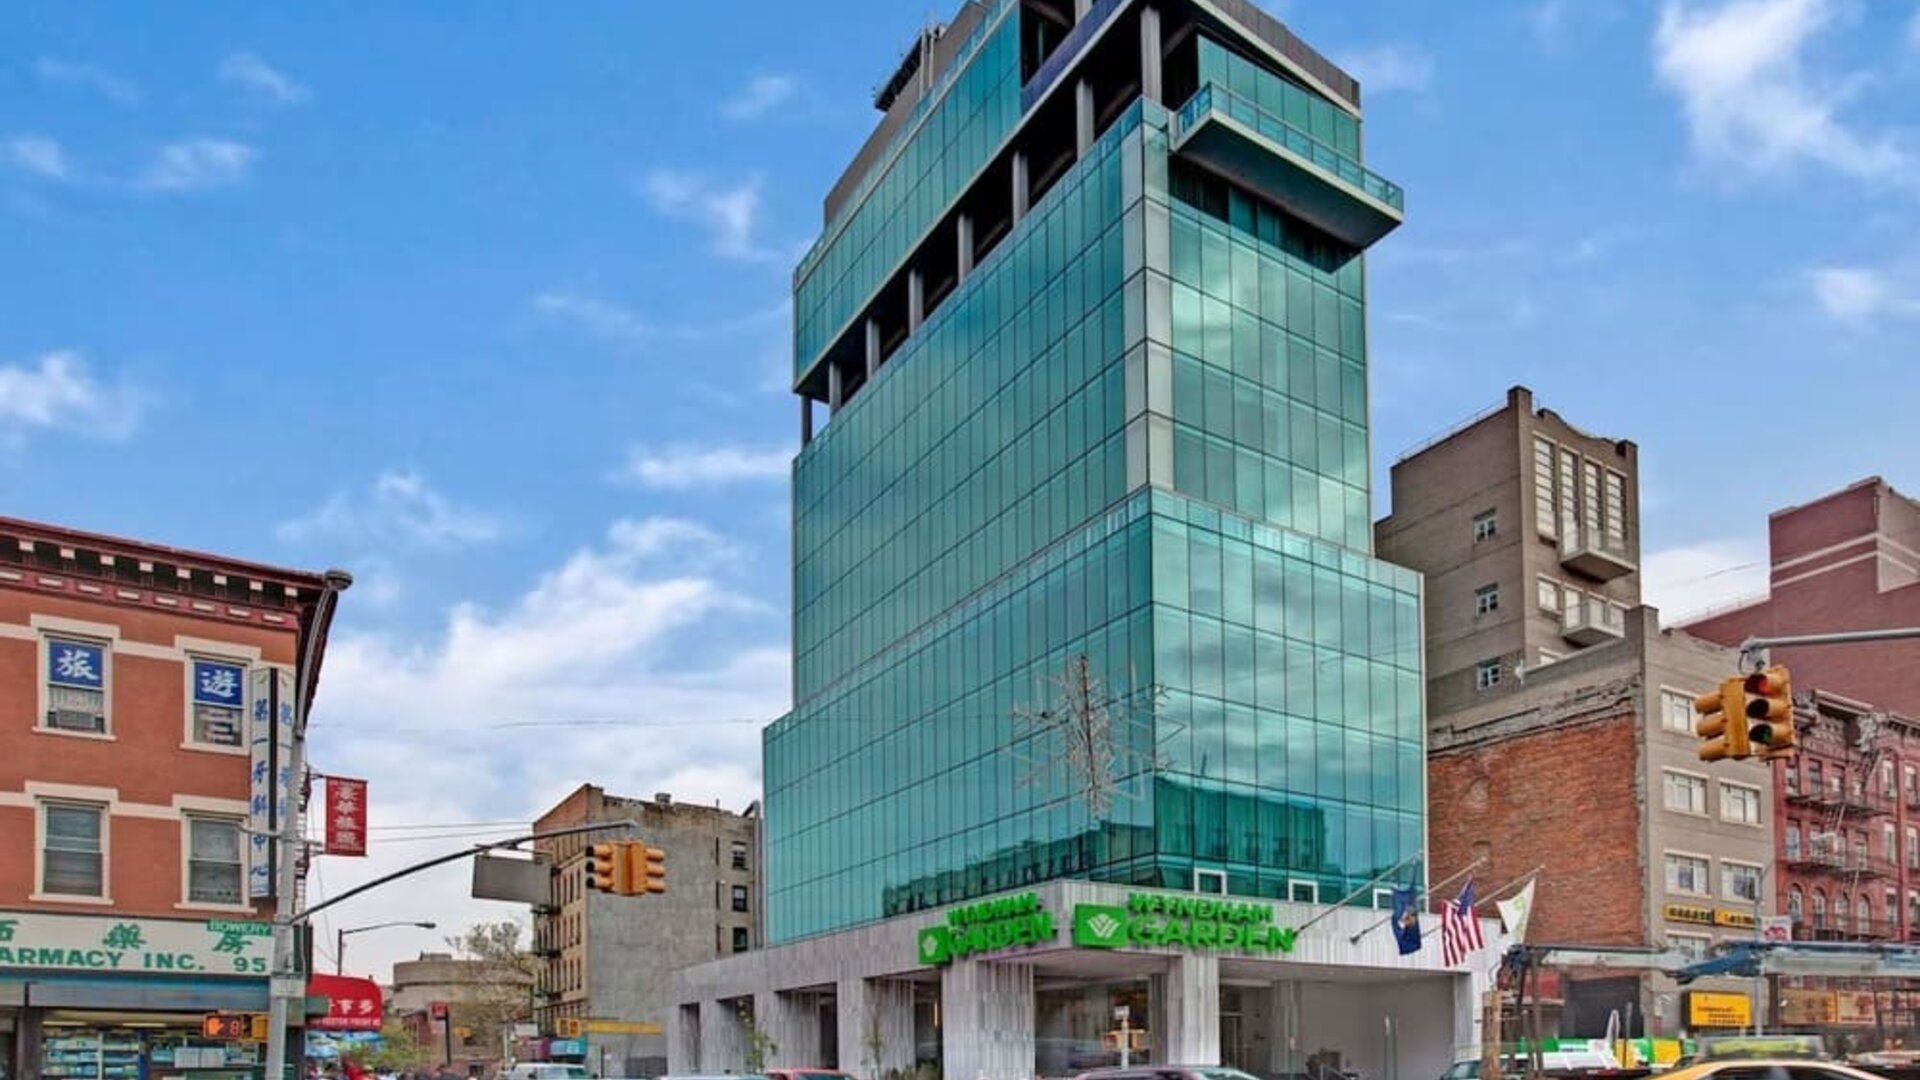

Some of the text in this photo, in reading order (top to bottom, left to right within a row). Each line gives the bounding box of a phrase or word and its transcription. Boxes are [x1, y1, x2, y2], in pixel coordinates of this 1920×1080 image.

[55, 649, 99, 680] 旅
[201, 670, 238, 698] 遊
[1128, 892, 1274, 923] WYNDHAM
[948, 911, 1053, 955] GARDEN
[1127, 916, 1295, 952] GARDEN
[143, 952, 205, 971] INC.
[233, 956, 267, 973] 95
